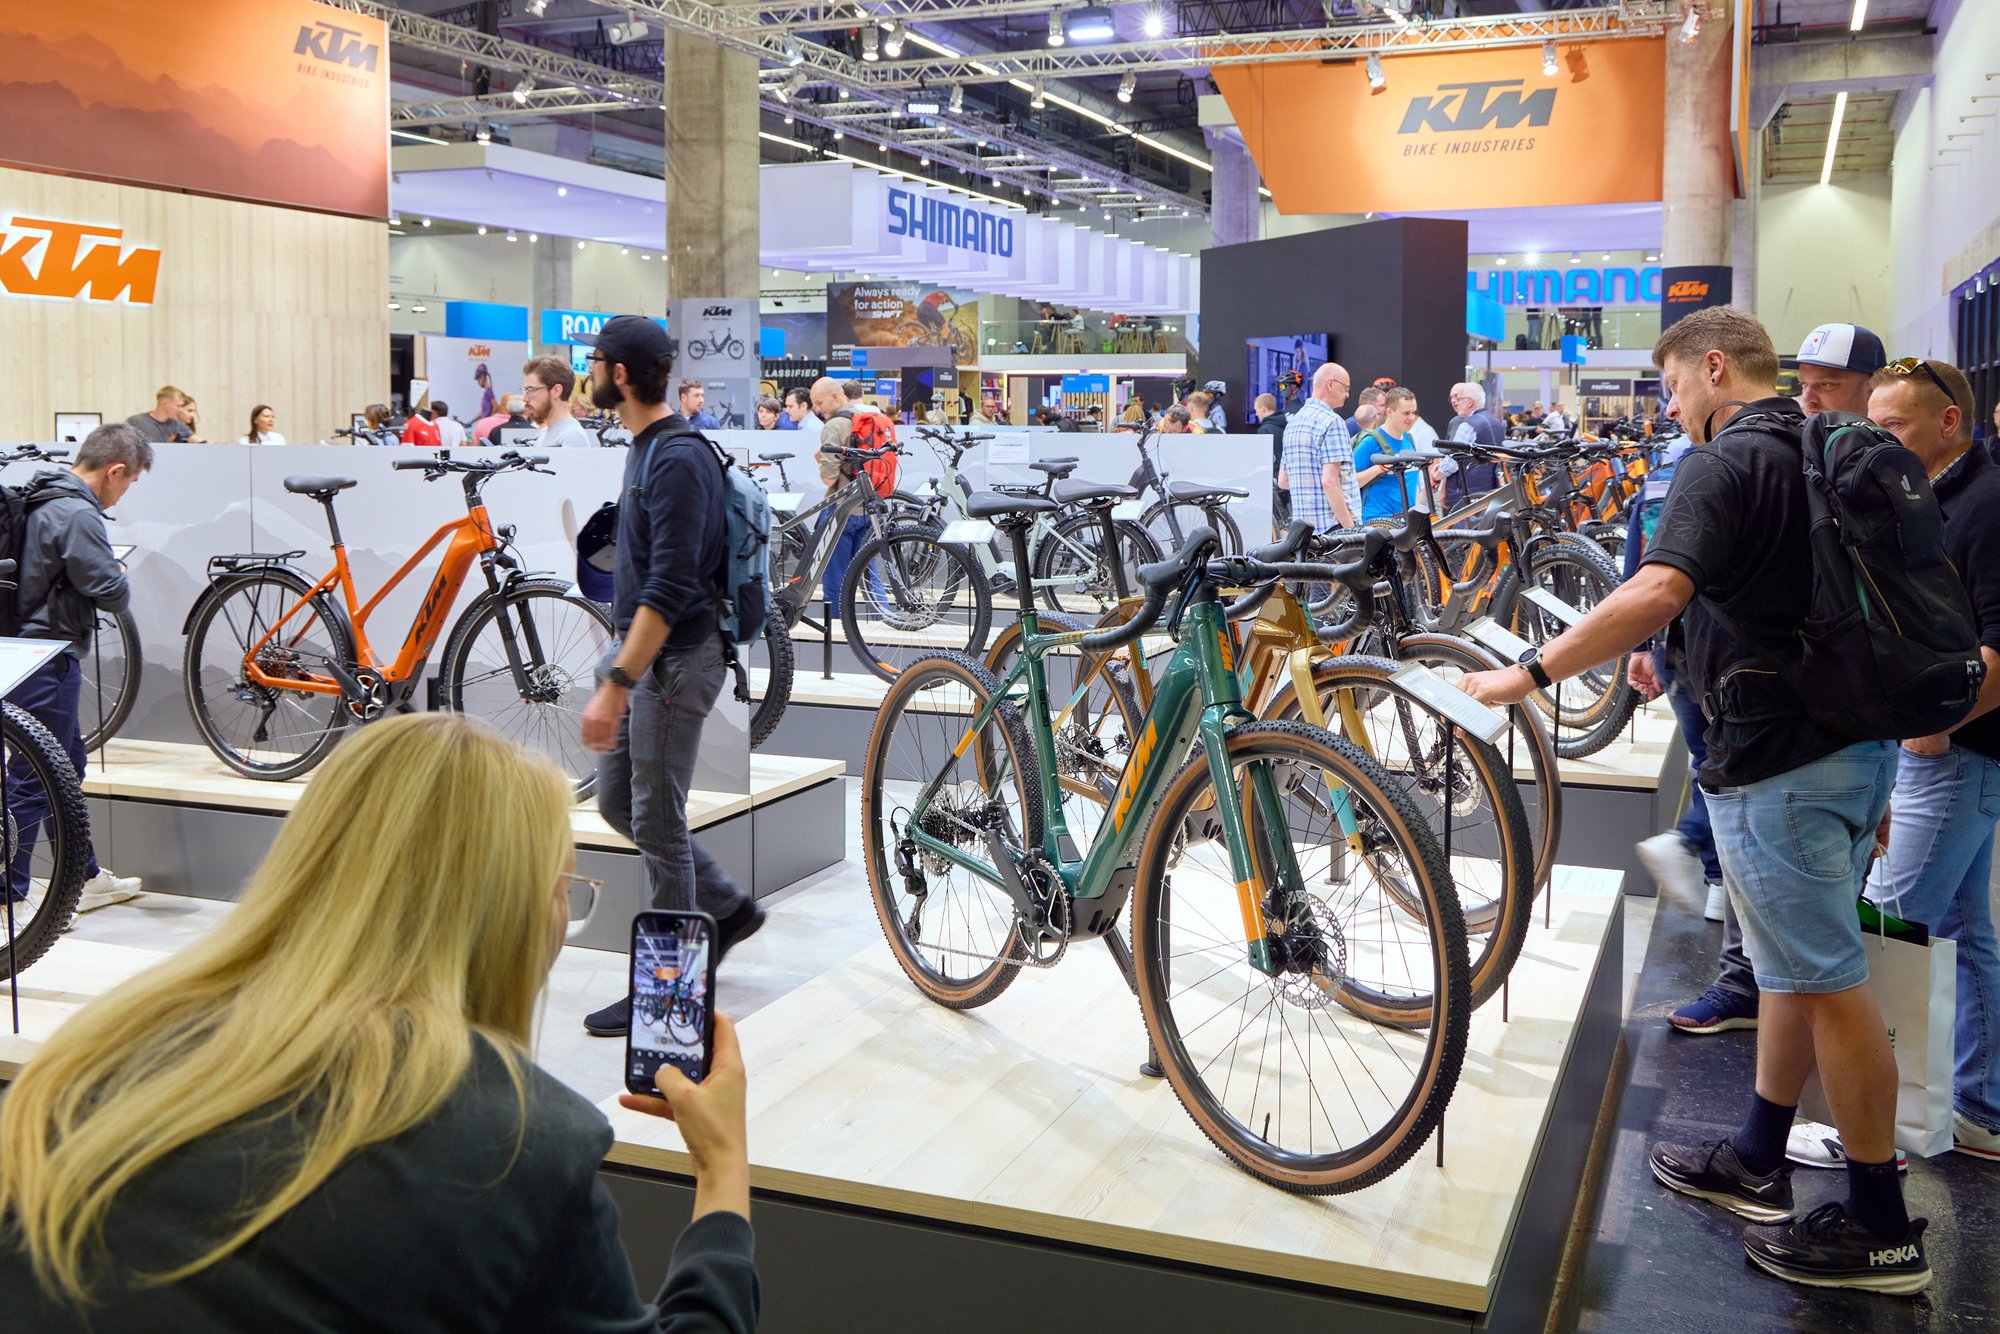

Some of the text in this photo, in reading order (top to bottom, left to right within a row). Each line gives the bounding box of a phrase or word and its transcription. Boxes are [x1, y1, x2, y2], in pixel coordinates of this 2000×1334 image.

[294, 21, 379, 73] KTM
[297, 63, 369, 88] BIKE INDUSTRIES
[1397, 79, 1558, 134] KTM
[1403, 137, 1536, 157] BIKE INDUSTRIES
[888, 187, 1013, 258] SHIMANO
[854, 286, 921, 298] Always ready
[1667, 281, 1710, 297] KTM
[702, 306, 733, 317] KTM
[854, 299, 904, 310] for action
[562, 314, 611, 341] ROA
[468, 344, 492, 357] KTM
[760, 369, 818, 378] LASSIFIED
[415, 574, 446, 645] KTM
[1217, 629, 1233, 673] KTM
[1114, 718, 1158, 834] KTM
[1869, 1244, 1919, 1267] HOKA
